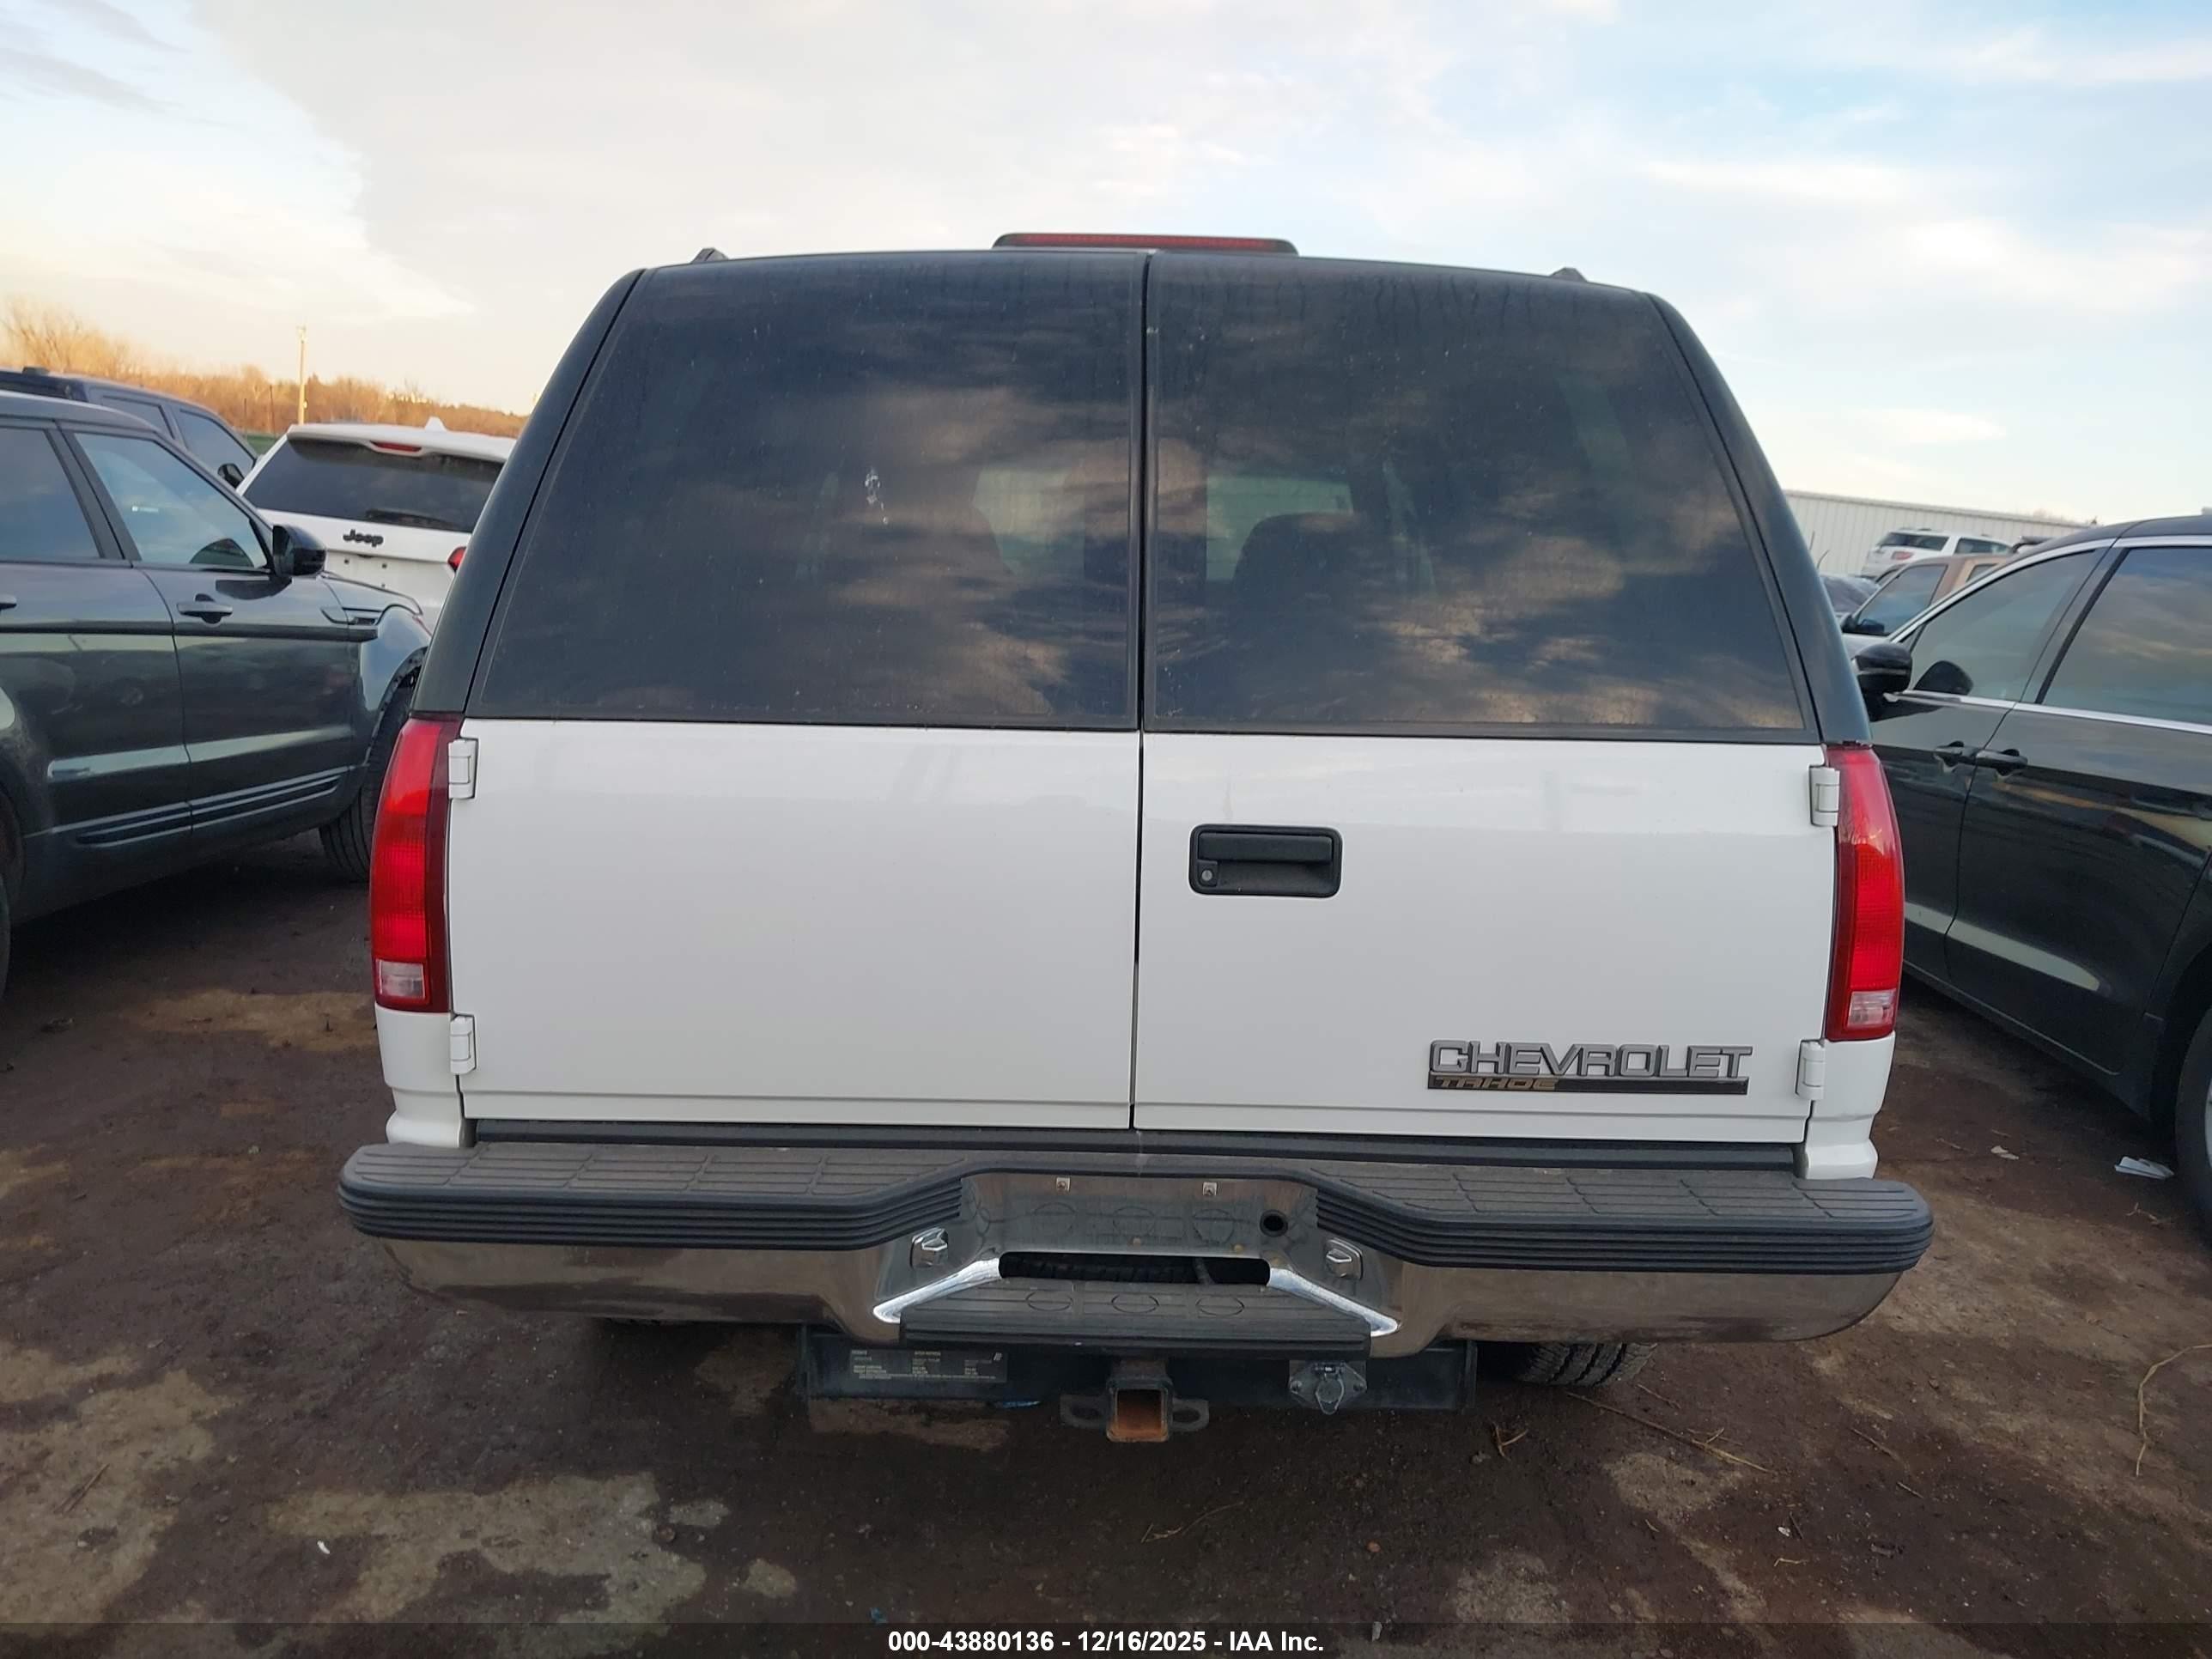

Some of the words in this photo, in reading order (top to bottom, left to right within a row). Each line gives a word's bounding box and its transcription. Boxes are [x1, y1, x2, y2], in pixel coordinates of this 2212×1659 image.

[343, 528, 384, 548] Jeep
[1430, 1040, 1753, 1079] CHEVROLET
[1434, 1076, 1559, 1092] TAHOE
